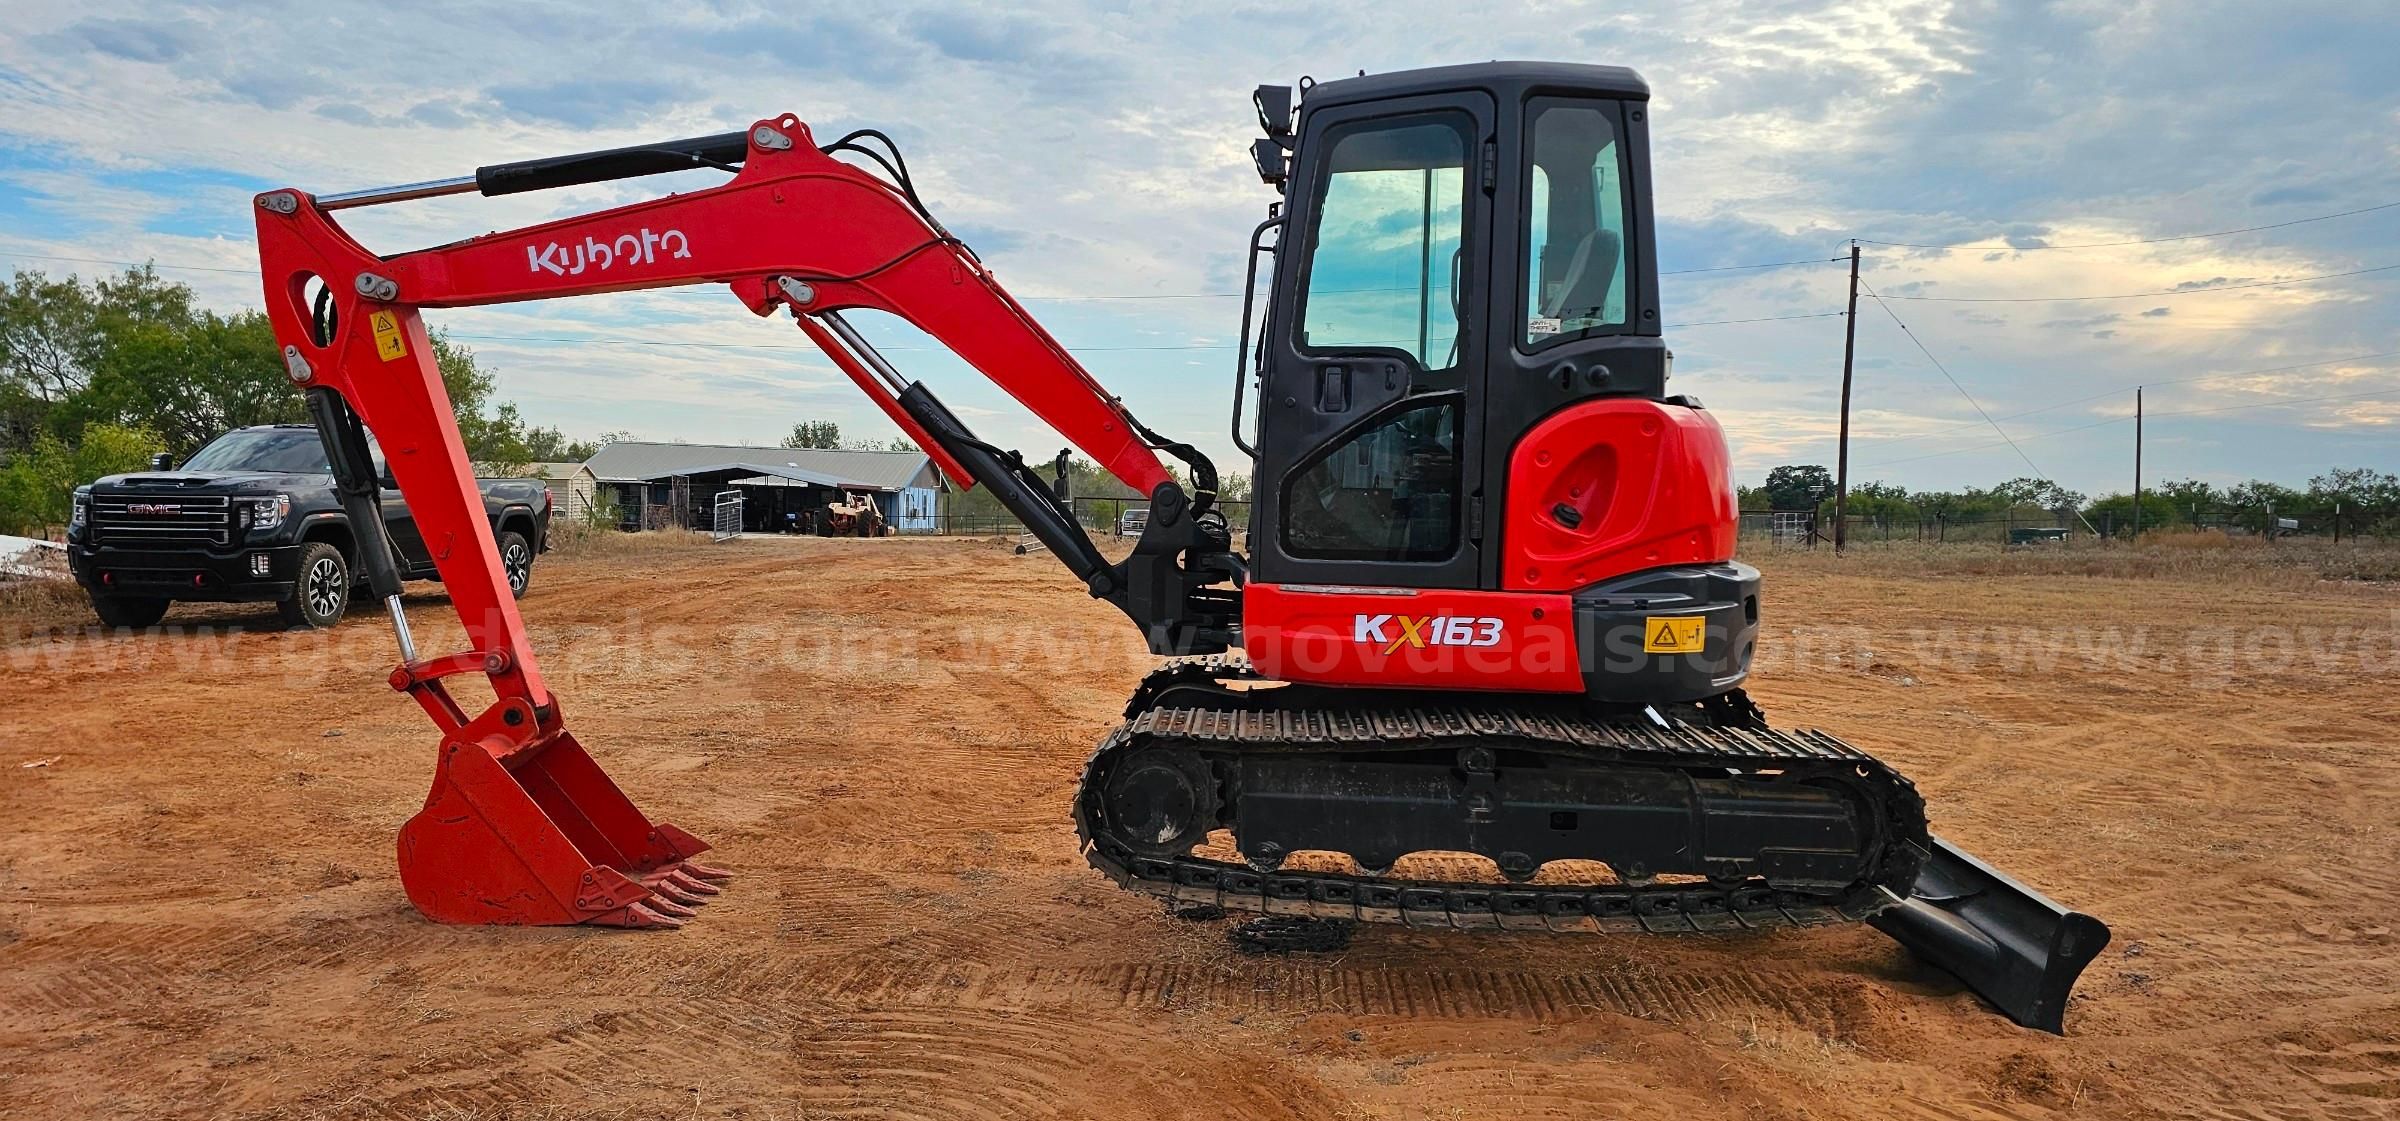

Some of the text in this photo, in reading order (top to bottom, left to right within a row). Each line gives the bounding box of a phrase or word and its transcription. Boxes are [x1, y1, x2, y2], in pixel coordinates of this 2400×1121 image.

[527, 228, 692, 277] Kubota
[127, 503, 181, 515] GMC
[1354, 614, 1504, 655] KX163
